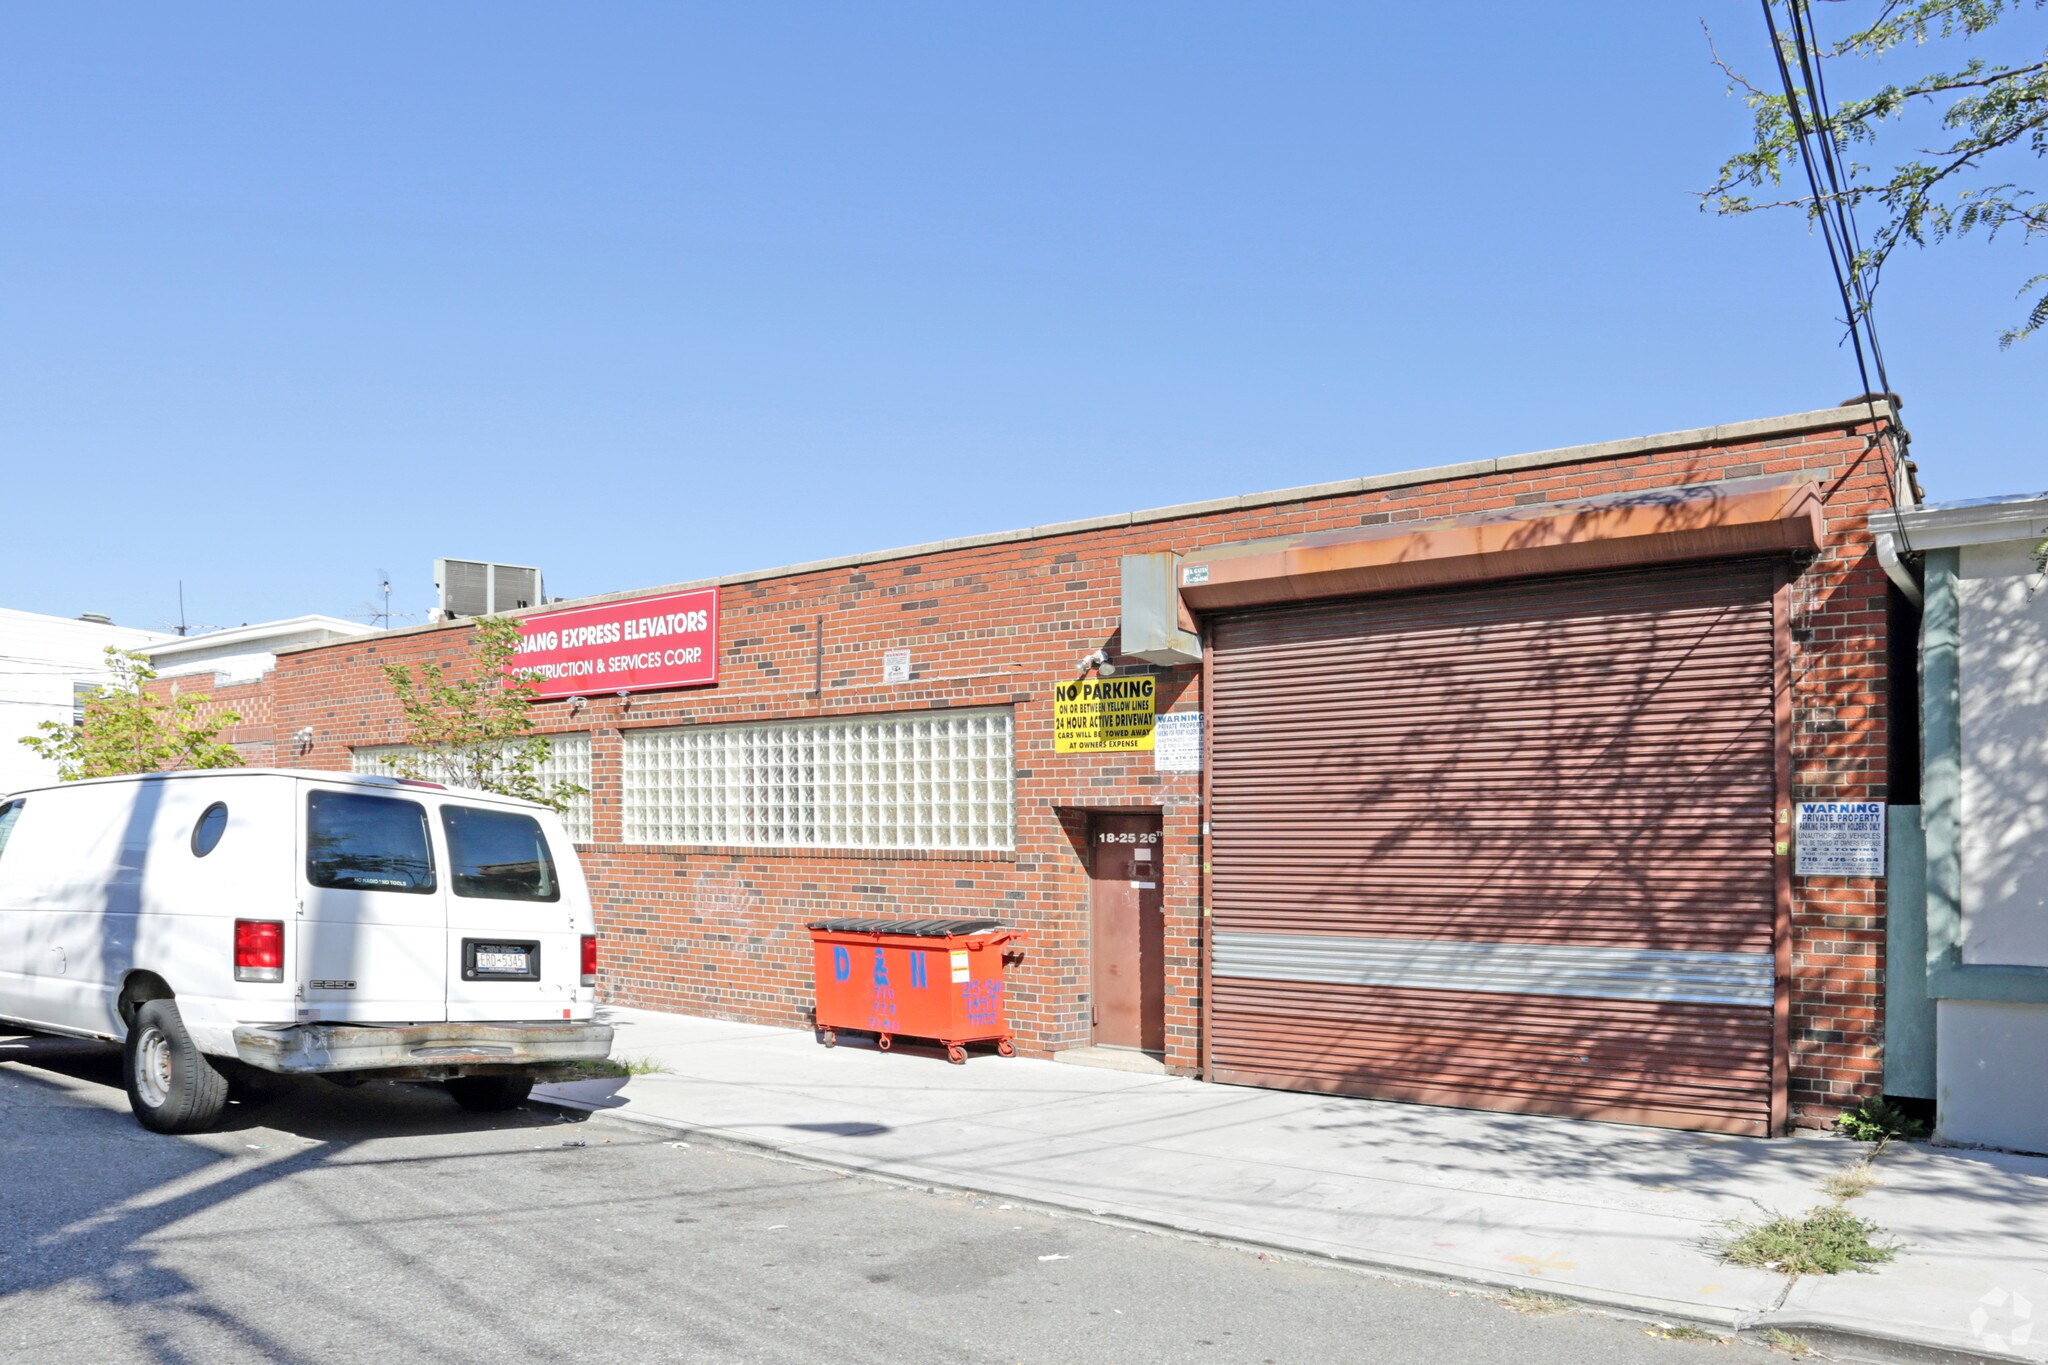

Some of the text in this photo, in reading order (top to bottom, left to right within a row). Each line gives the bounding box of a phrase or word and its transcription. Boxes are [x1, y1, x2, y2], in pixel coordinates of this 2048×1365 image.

[508, 610, 707, 655] HANG EXPRESS ELEVATORS
[597, 658, 606, 674] &
[608, 651, 661, 672] SERVICES
[664, 647, 702, 666] CORP.
[1056, 680, 1153, 702] NO PARKING
[1059, 700, 1149, 714] ON OR BETWEEN YELLOW LINES
[1056, 712, 1153, 729] 24 HOUR ACTIVE DRIVEWAY
[1157, 714, 1204, 723] WARNING
[1058, 731, 1073, 739] CARS
[1093, 730, 1101, 738] BE
[1106, 729, 1129, 737] TOWED
[1131, 728, 1151, 736] AWAY
[1079, 740, 1106, 749] OWNERS
[1109, 739, 1138, 748] EXPENSE
[1802, 803, 1879, 813] WARNING
[1802, 814, 1880, 822] PRIVATE PROPERTY
[1799, 823, 1880, 831] PARKING FOR PERMIT HOLDERS ONLY
[1099, 833, 1136, 843] 18-25
[833, 946, 851, 982] D
